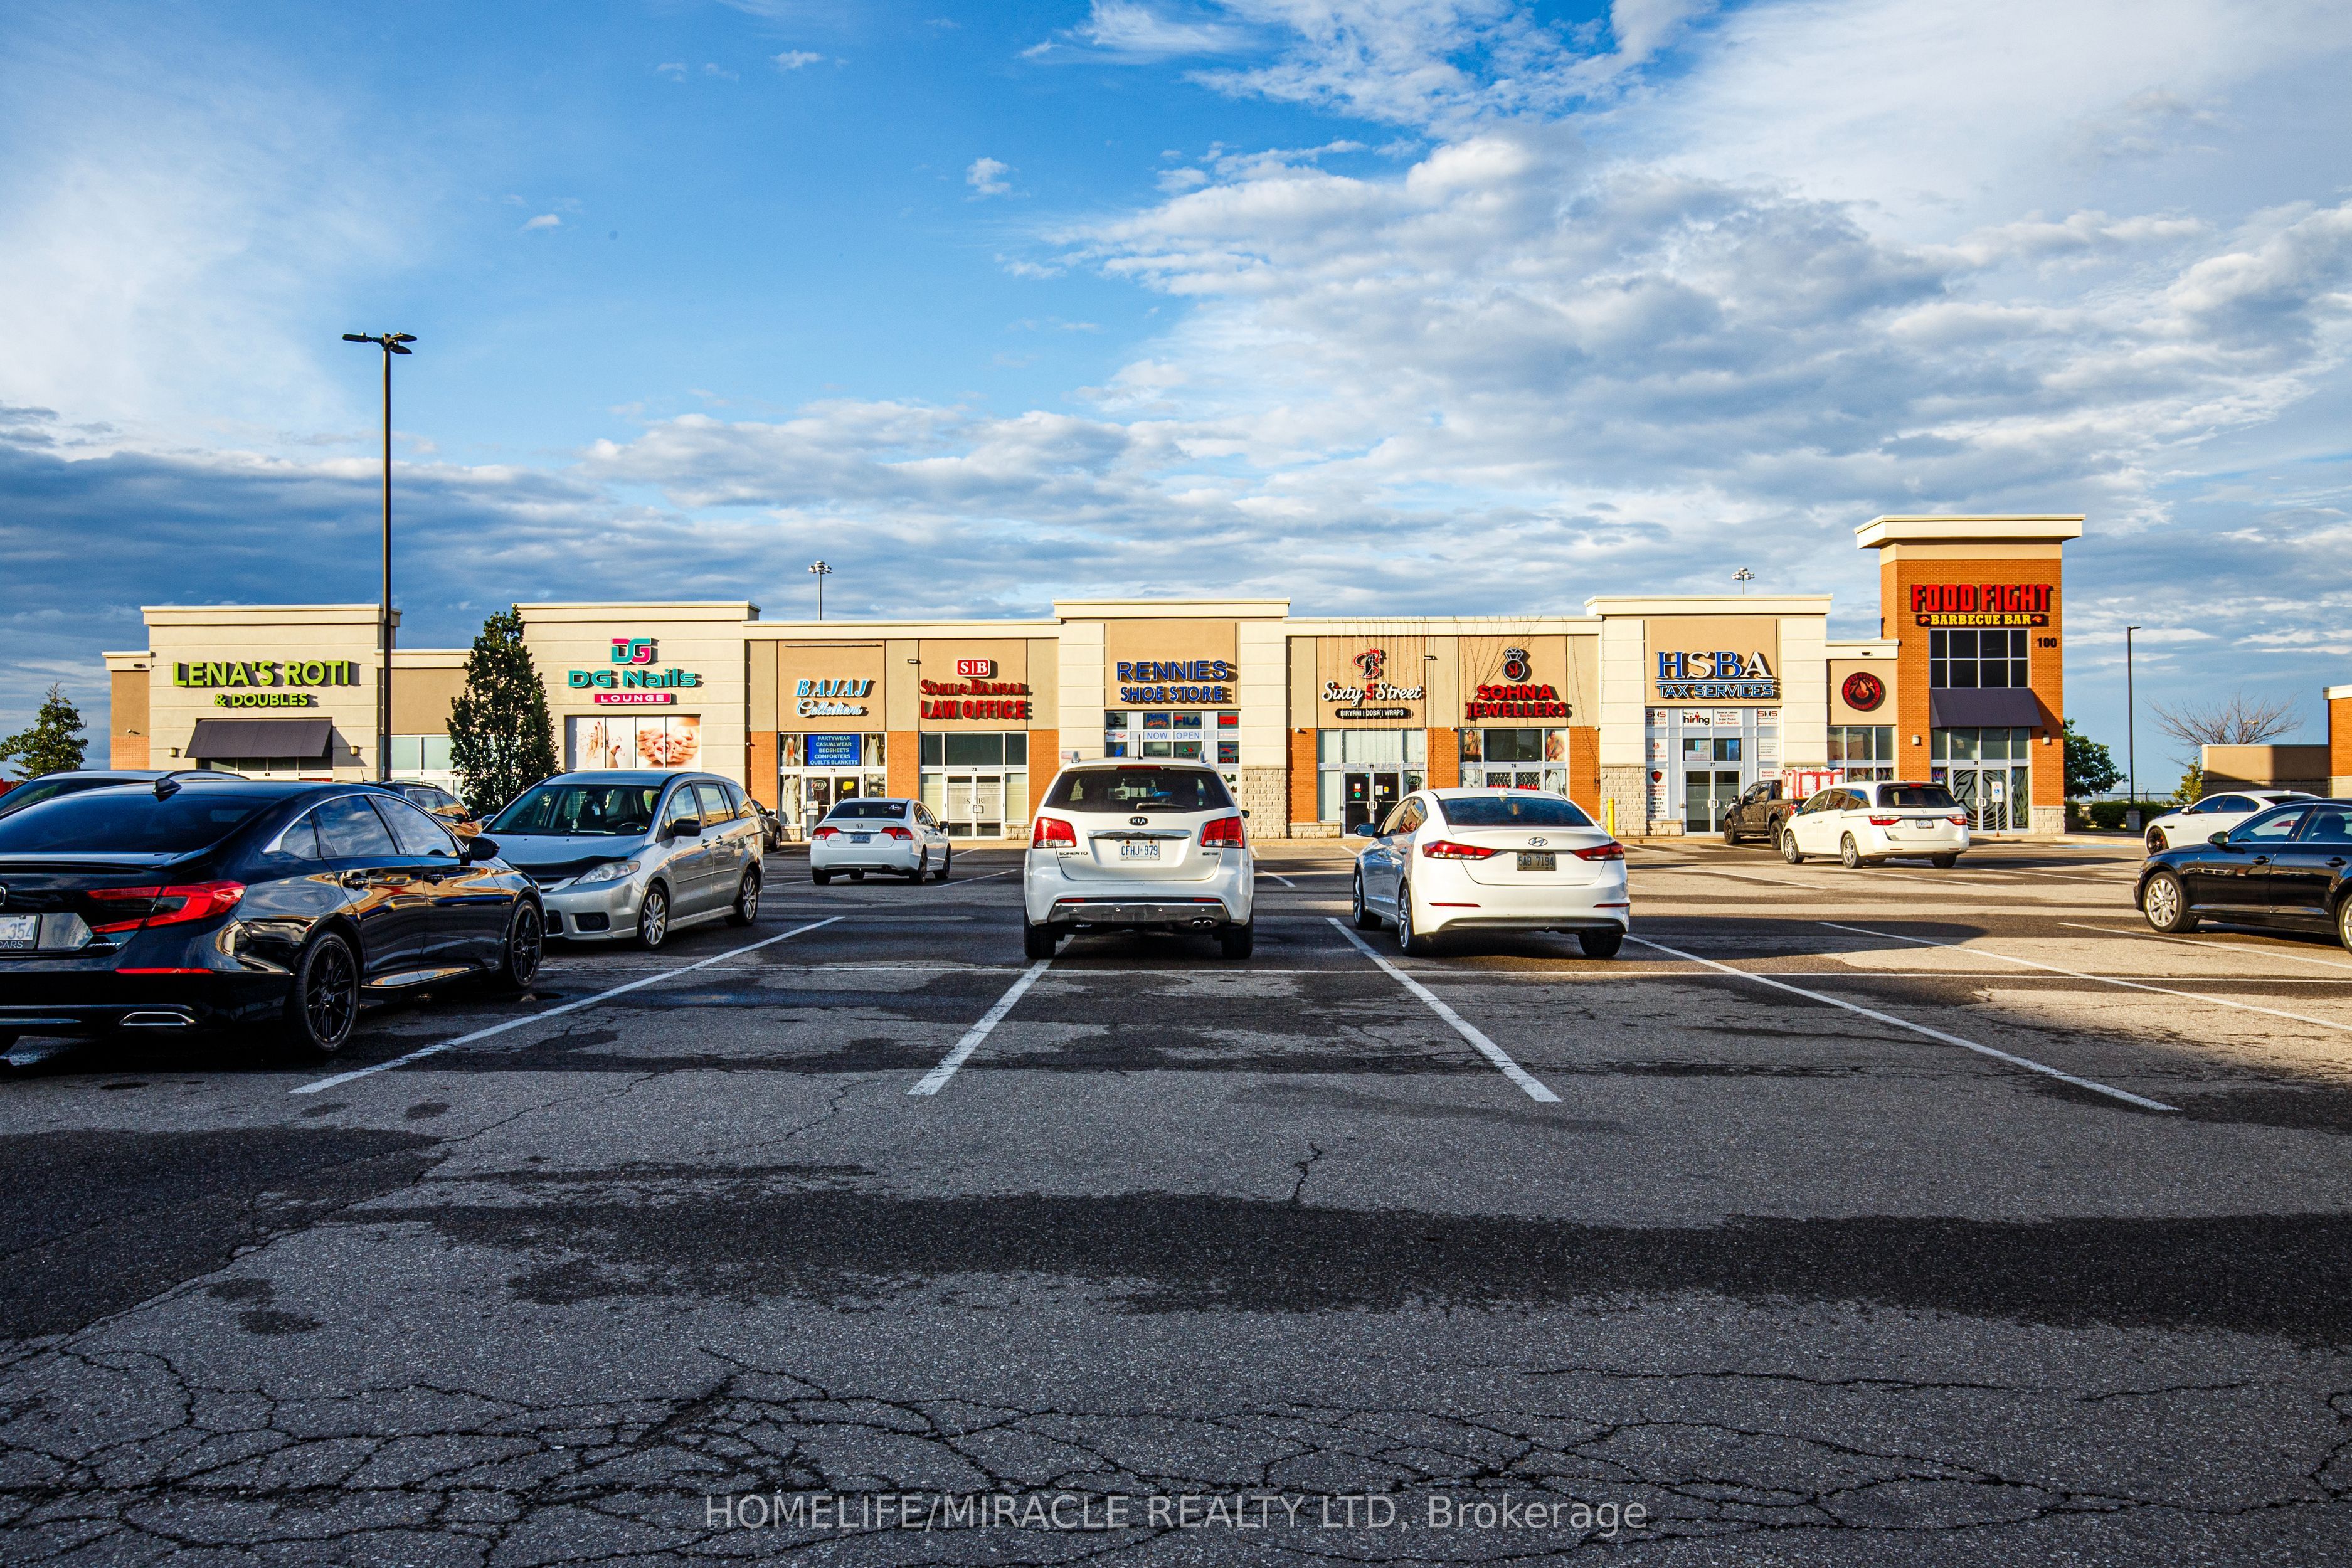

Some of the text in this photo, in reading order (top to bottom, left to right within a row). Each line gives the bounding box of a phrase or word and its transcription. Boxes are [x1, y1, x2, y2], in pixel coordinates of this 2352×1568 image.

[1911, 584, 2050, 611] FOOD FIGHT
[1930, 614, 2032, 625] BARBECUE BAR
[2037, 637, 2057, 648] 100
[173, 660, 350, 686] LENA'S ROTI
[1116, 659, 1229, 682] RENNIES
[1655, 650, 1774, 679] HSBA
[568, 668, 697, 687] DG Nails
[920, 678, 1026, 694] SOHI & BANSAL
[794, 679, 869, 697] BAJAJ
[1120, 685, 1223, 702] SHOE STORE
[1321, 681, 1422, 707] Sixty 5 Street
[1476, 684, 1554, 700] SOHNA
[1656, 684, 1774, 697] TAX SERVICES
[214, 692, 309, 707] & DOUBLES
[600, 694, 664, 702] LOUNGE
[797, 697, 863, 718] Collections
[921, 699, 1026, 718] LAW OFFICE
[1465, 701, 1567, 720] JEWELLERS
[1174, 715, 1201, 727] FILA
[1683, 711, 1710, 726] hiring
[1121, 845, 1158, 856] CFHJ 979
[1535, 856, 1554, 866] 7194
[8, 923, 34, 940] 354
